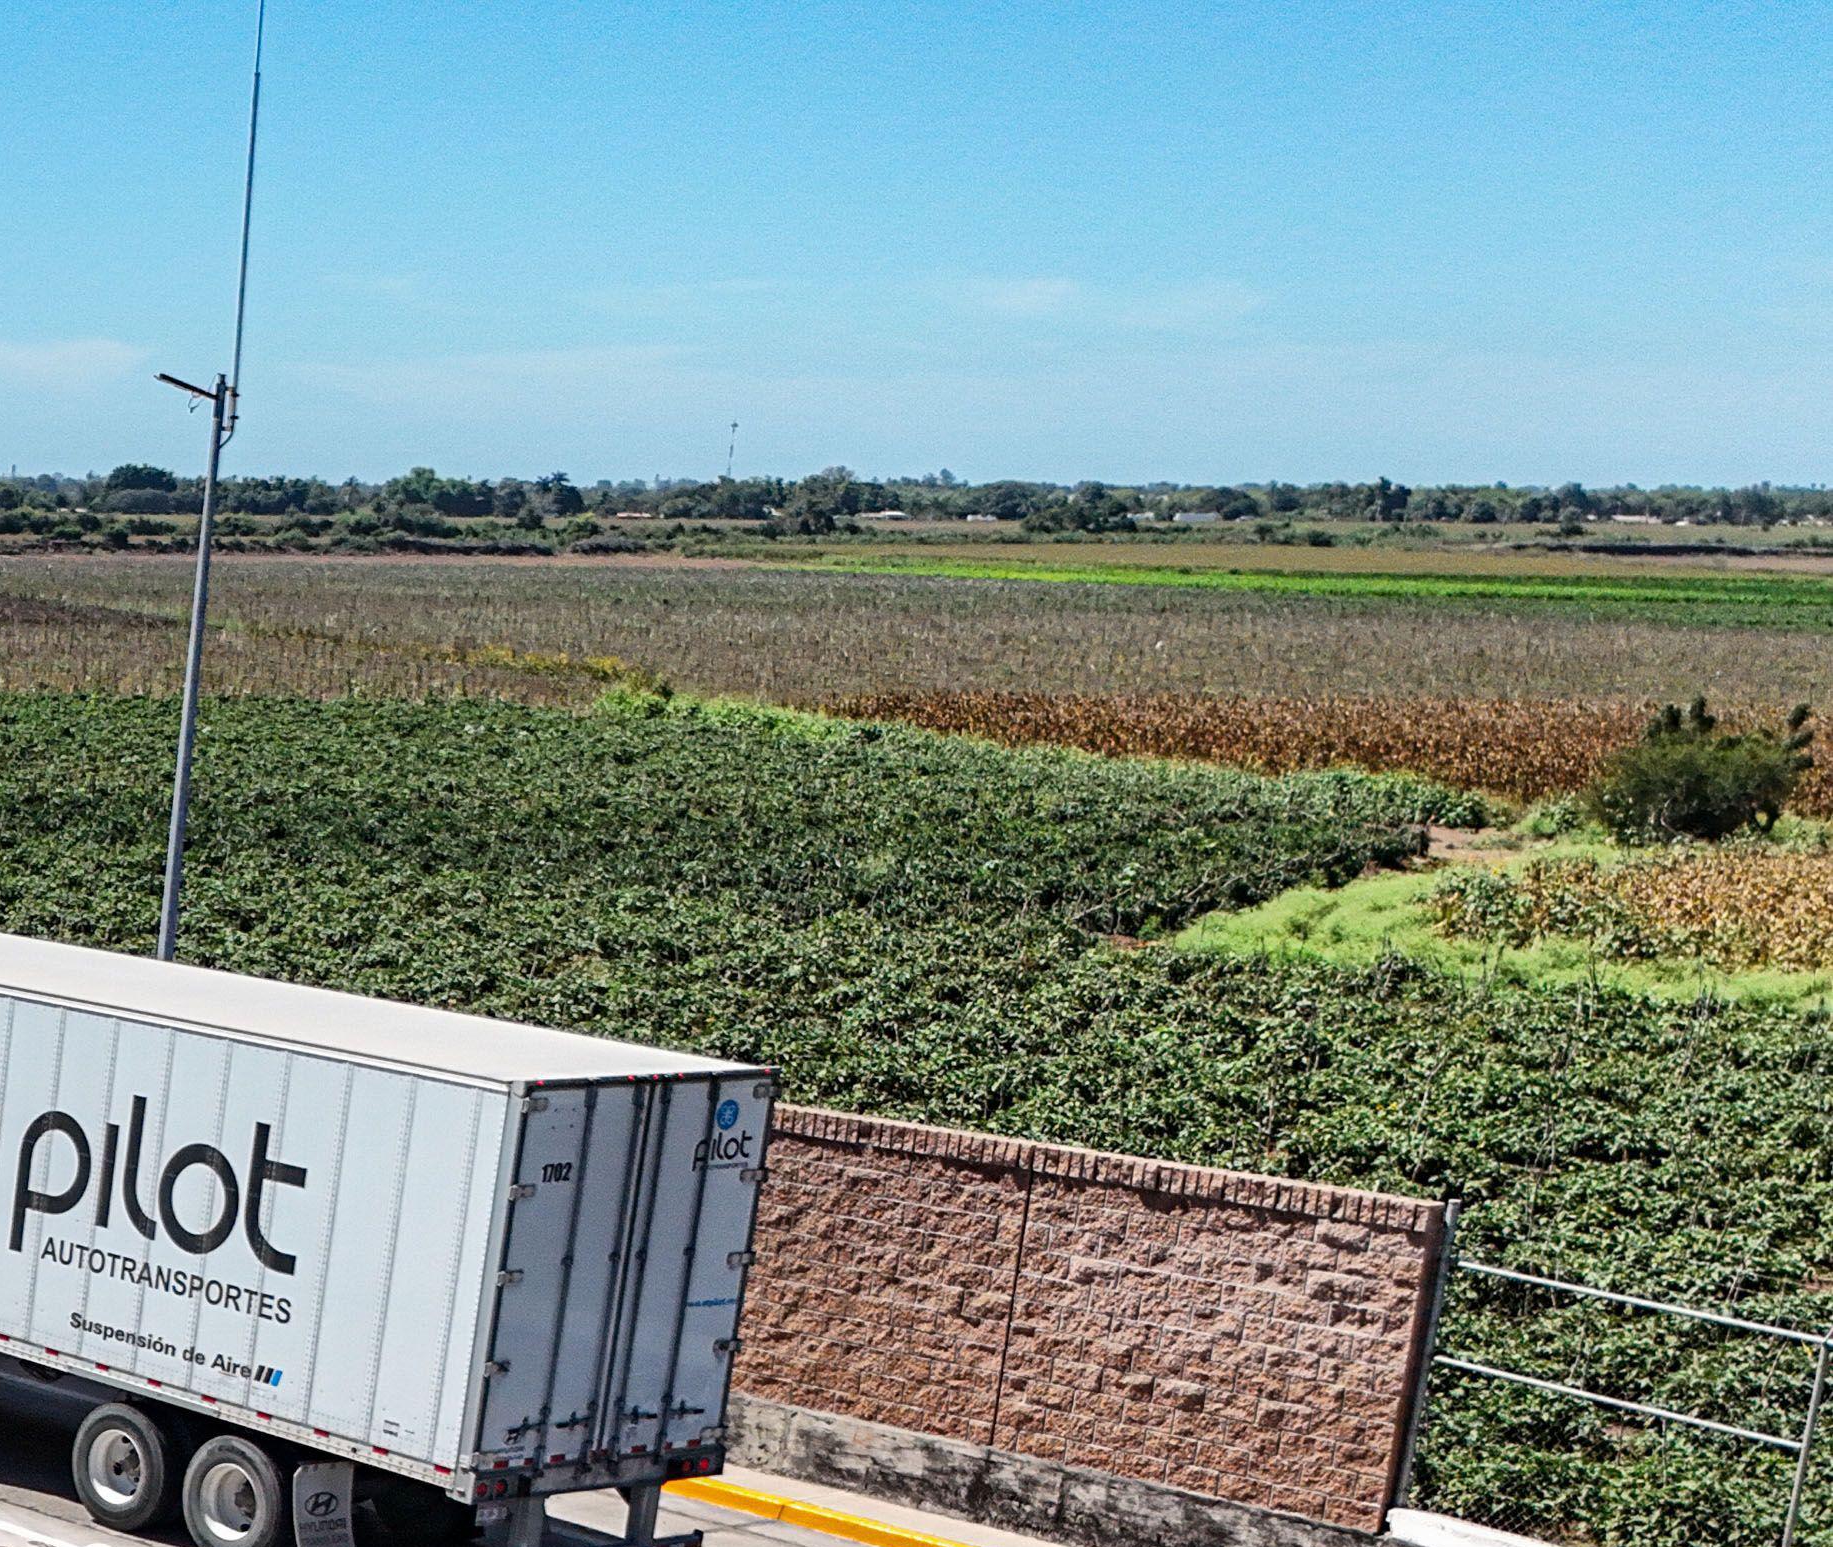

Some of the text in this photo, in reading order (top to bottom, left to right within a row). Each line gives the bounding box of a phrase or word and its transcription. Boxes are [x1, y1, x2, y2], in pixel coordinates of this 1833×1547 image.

[9, 1095, 307, 1275] pilot
[692, 1130, 752, 1171] pilot
[40, 1237, 293, 1324] AUTOTRANSPORTES
[69, 1312, 252, 1379] Suspensión de Aire
